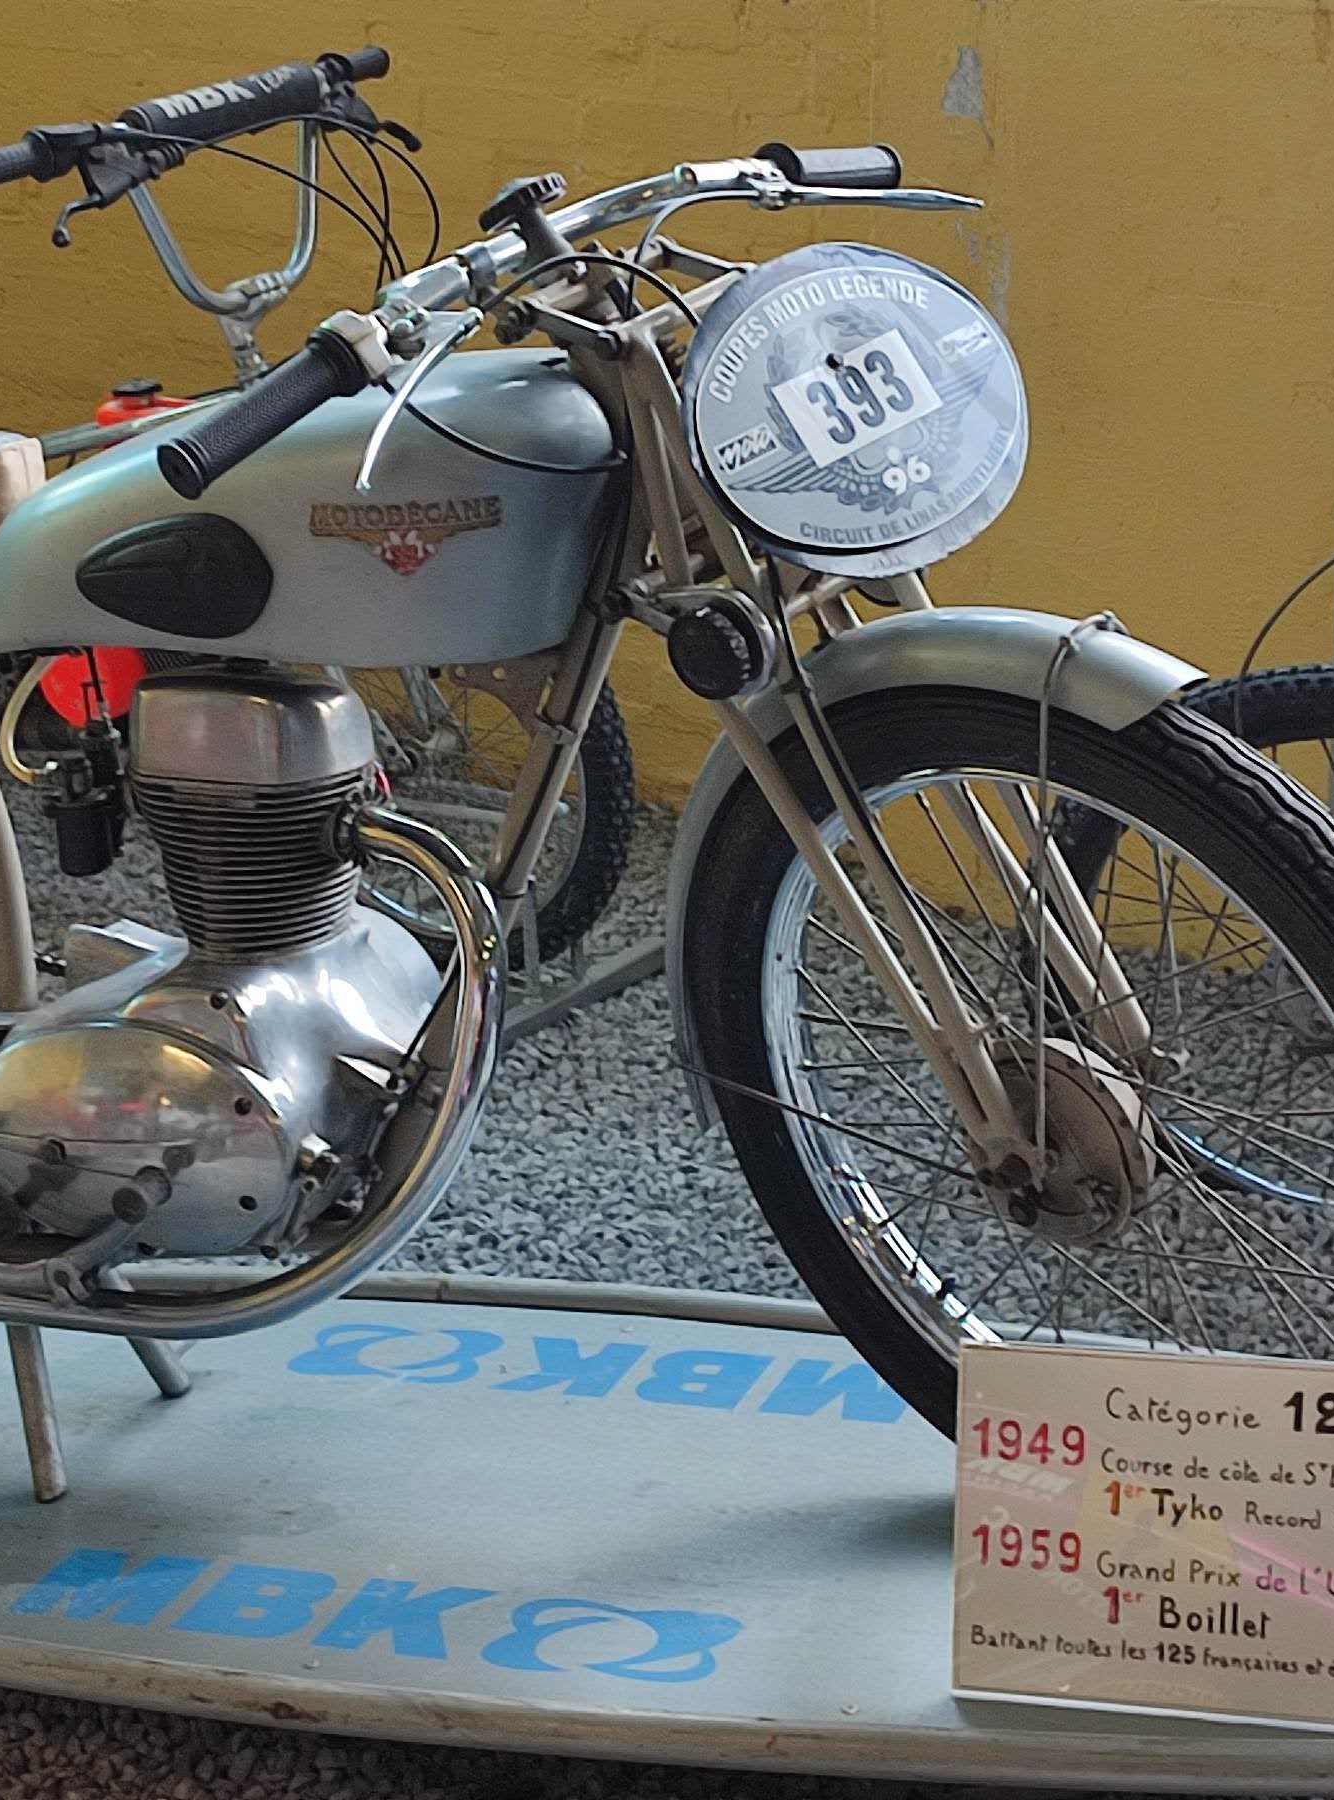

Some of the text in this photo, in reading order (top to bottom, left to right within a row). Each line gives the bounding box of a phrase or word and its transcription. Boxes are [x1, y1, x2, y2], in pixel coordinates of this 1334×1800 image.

[152, 80, 256, 119] MBK
[708, 272, 930, 404] COUPES MOTO LEGENDE
[806, 350, 915, 445] 393
[882, 455, 932, 496] 96
[799, 521, 877, 545] CIRCUIT
[877, 519, 906, 539] DE
[489, 1333, 909, 1425] MBK
[1106, 1387, 1260, 1435] Catégorie
[972, 1417, 1085, 1466] 1949
[1101, 1447, 1172, 1477] Course
[1183, 1456, 1209, 1479] de
[1219, 1459, 1260, 1484] côte
[1270, 1464, 1294, 1485] de
[1151, 1487, 1223, 1527] Tyko
[1245, 1501, 1321, 1530] Record
[972, 1524, 1082, 1574] 1959
[1097, 1550, 1175, 1583] Grand
[1189, 1559, 1241, 1588] Prix
[1255, 1564, 1287, 1593] de
[13, 1548, 493, 1660] MBK
[1159, 1595, 1272, 1639] Boillet
[971, 1624, 1048, 1653] Battant
[1056, 1634, 1111, 1658] toutes
[1121, 1640, 1146, 1660] les
[1154, 1642, 1196, 1665] 125
[1203, 1650, 1298, 1676] françaises
[1305, 1657, 1324, 1676] et
